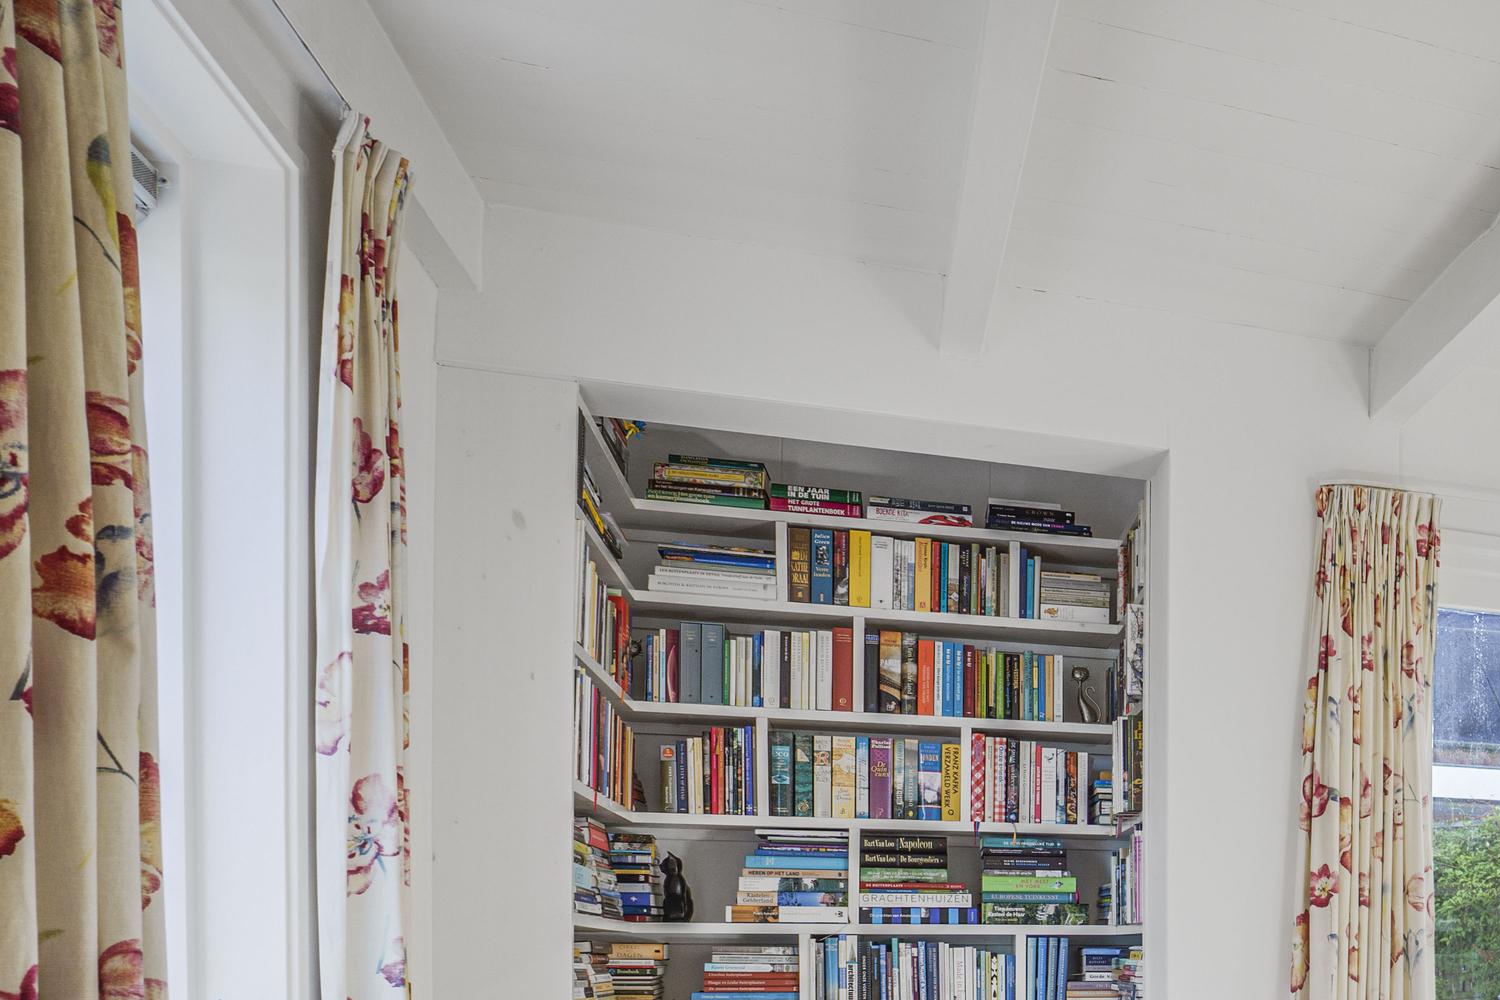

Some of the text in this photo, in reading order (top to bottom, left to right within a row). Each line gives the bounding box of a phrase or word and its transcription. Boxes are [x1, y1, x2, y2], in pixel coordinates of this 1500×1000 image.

[787, 485, 830, 494] EEN JAAR
[811, 492, 830, 500] TUIN
[788, 506, 845, 516] TUINPLANTENBOEK
[864, 838, 933, 851] Bart Van Loo Napoleon
[865, 854, 876, 862] Bart
[876, 854, 886, 862] Van
[748, 868, 766, 876] HEREN
[862, 894, 969, 903] GRACHTENHUIZEN
[956, 960, 964, 979] Made
